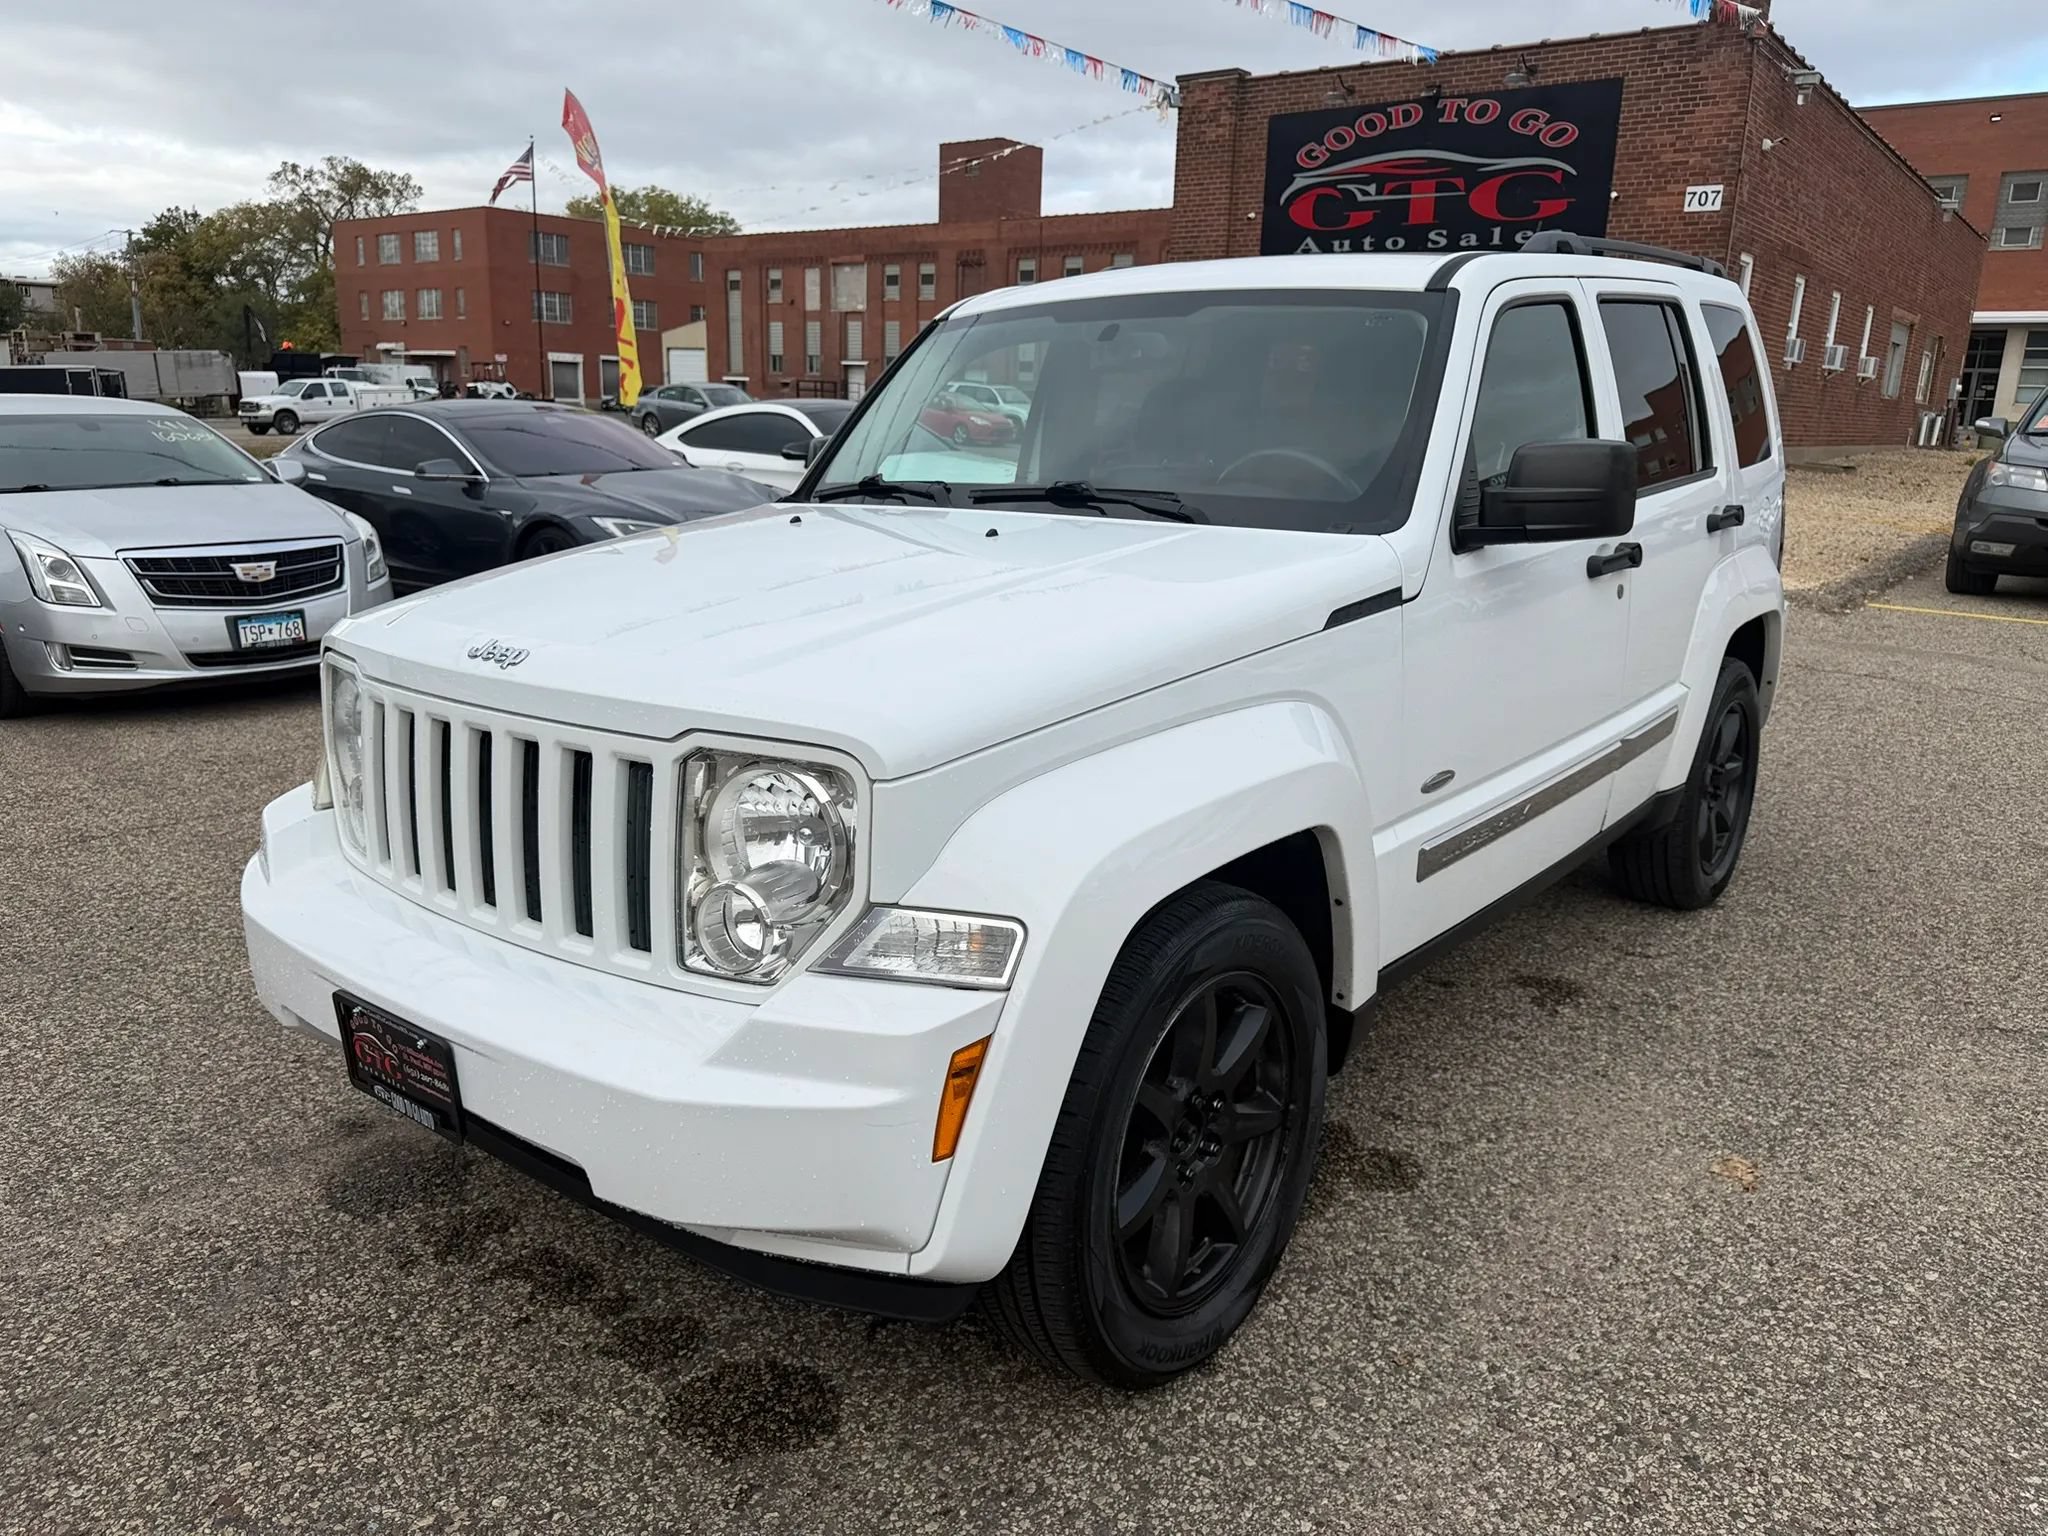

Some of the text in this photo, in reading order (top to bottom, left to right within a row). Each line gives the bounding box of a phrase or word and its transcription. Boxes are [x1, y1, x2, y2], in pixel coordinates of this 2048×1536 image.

[1296, 98, 1579, 168] GOOD TO GO
[1288, 169, 1577, 231] GTG
[1687, 190, 1721, 207] 707
[1296, 226, 1534, 254] Auto Sale
[241, 620, 301, 643] TSP 768
[467, 639, 531, 670] Jeep
